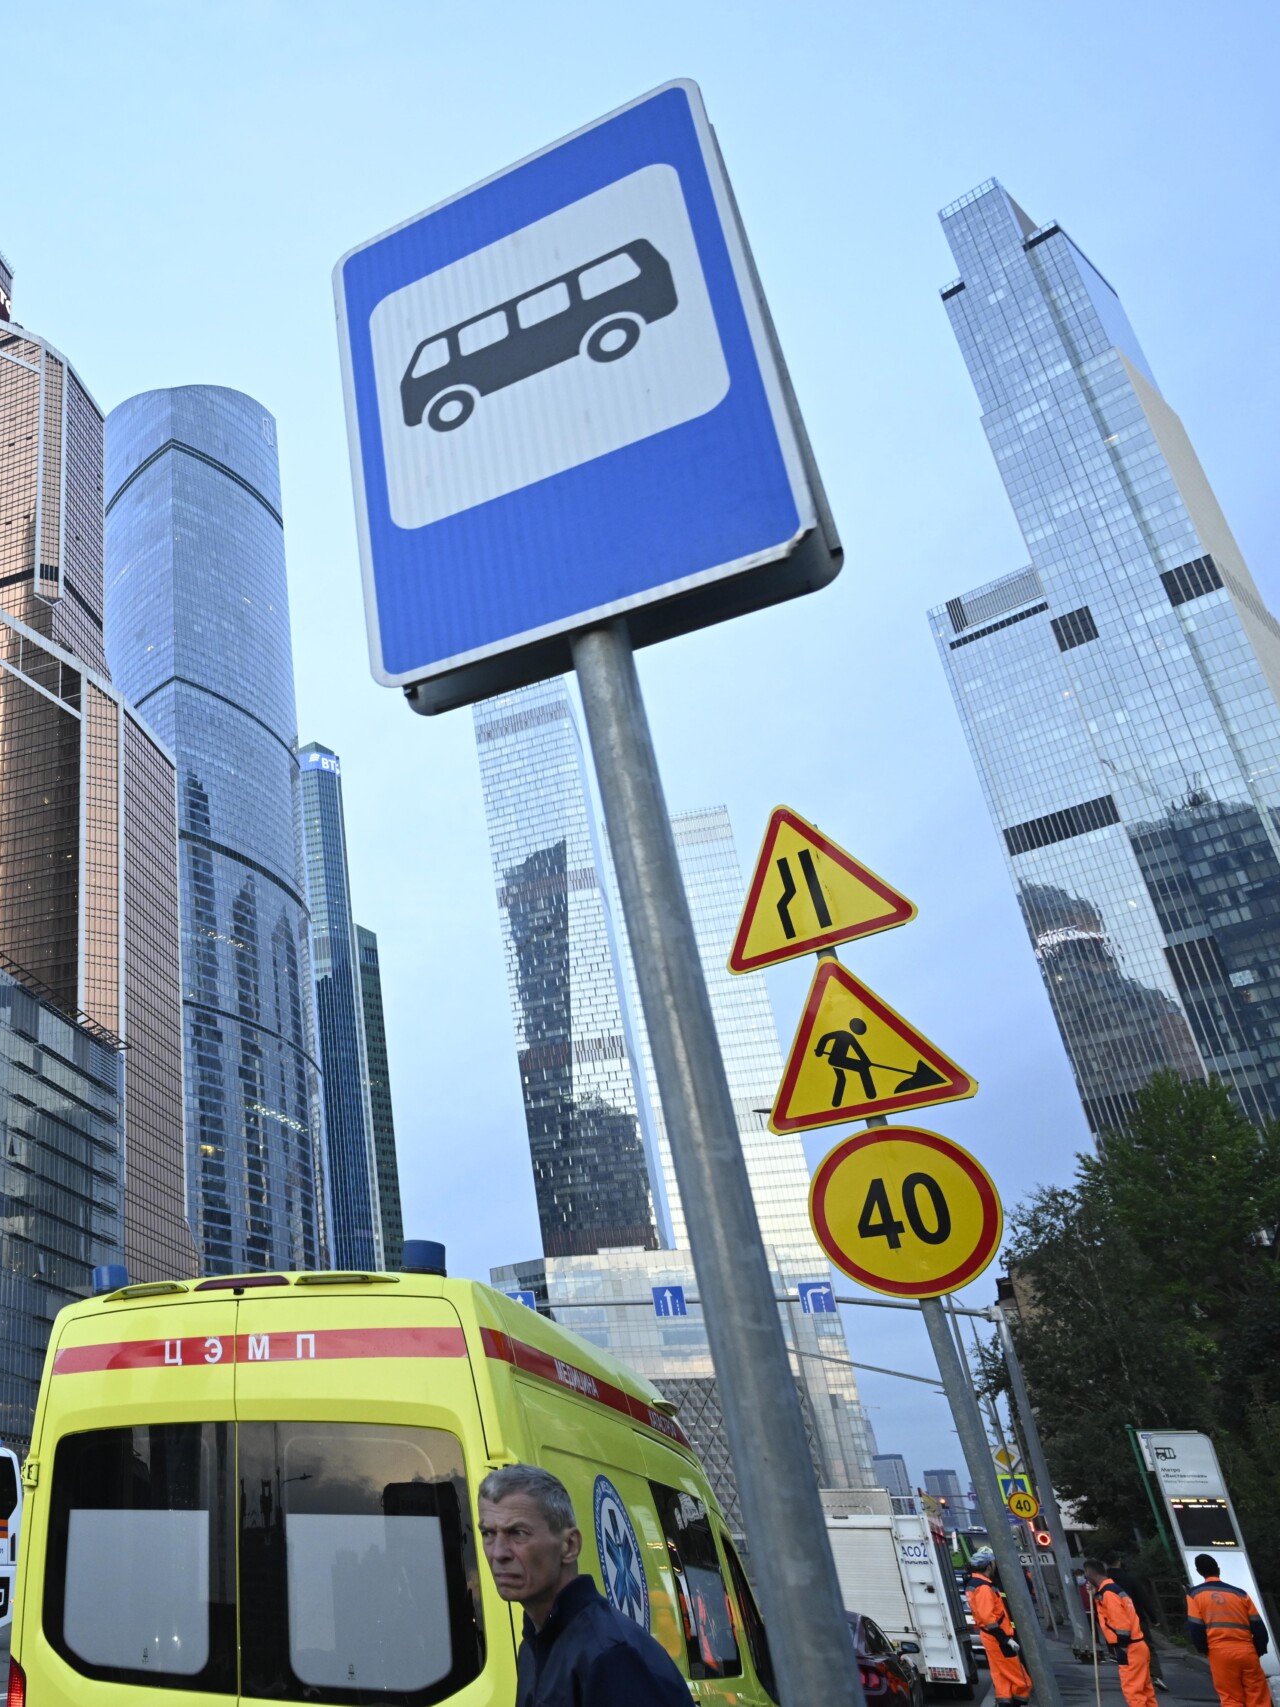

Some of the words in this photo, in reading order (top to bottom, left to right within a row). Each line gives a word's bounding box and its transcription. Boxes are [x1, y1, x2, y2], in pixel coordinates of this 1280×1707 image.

[858, 1172, 951, 1250] 40
[164, 1334, 316, 1367] ЦЭМП
[553, 1358, 600, 1398] МЕДИЦИНА
[1015, 1500, 1032, 1512] 40
[1020, 1554, 1049, 1564] СТП
